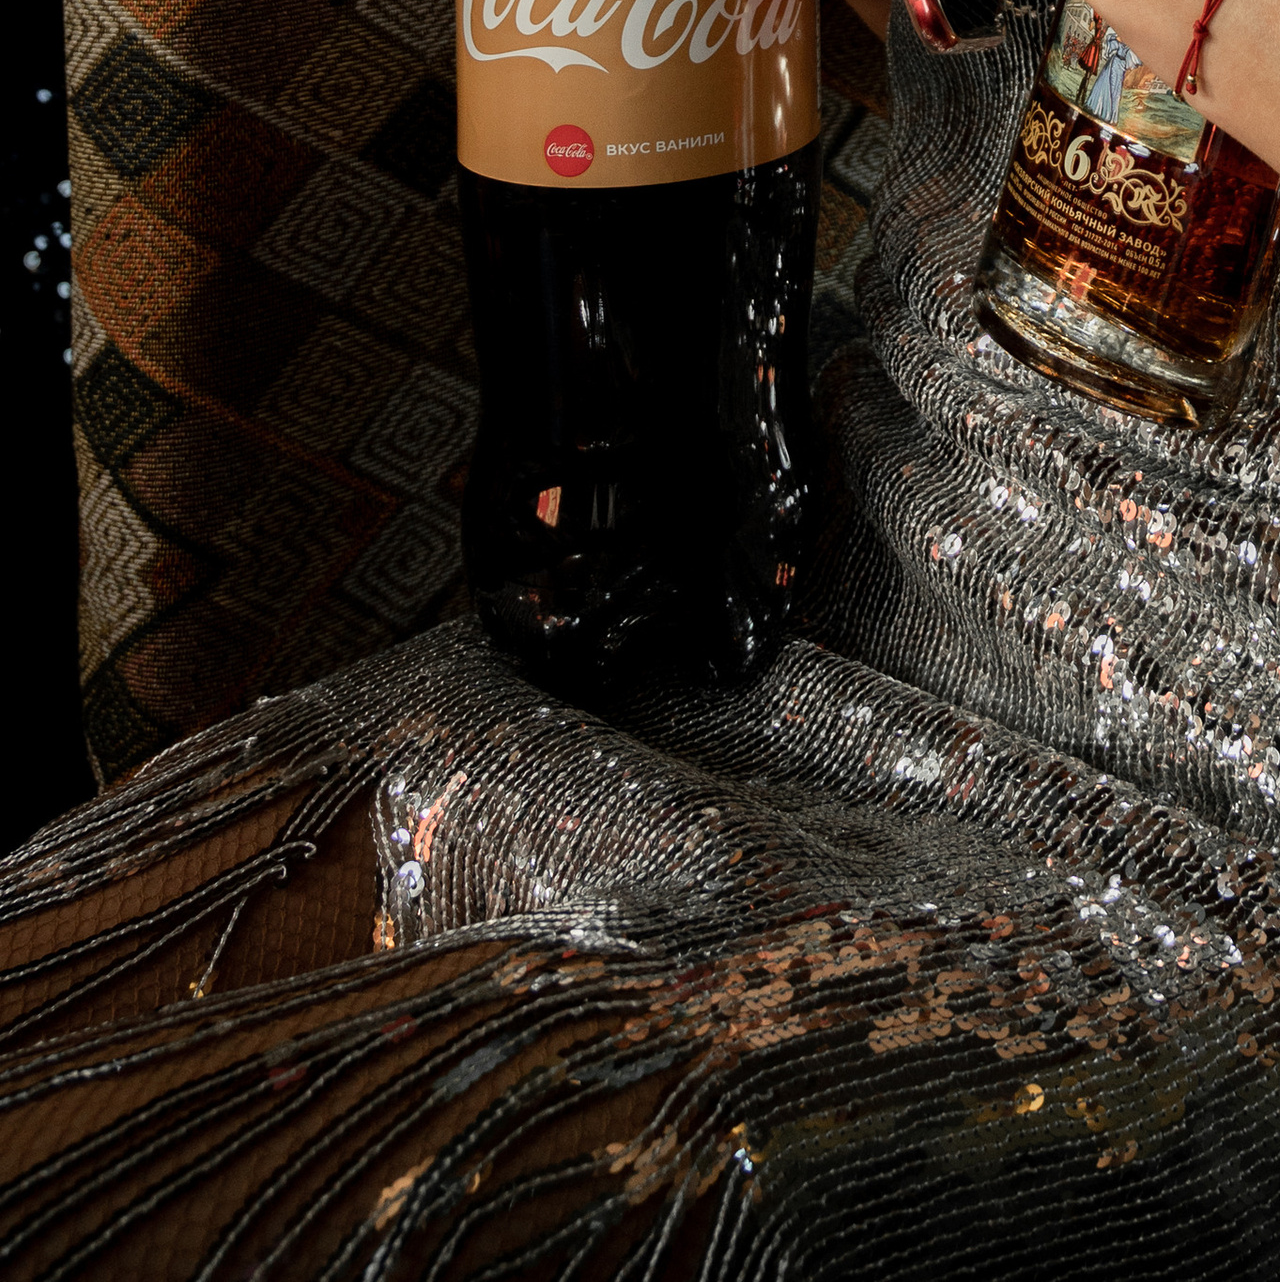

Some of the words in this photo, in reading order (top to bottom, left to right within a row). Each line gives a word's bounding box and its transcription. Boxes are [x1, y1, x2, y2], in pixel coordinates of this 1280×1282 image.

[546, 142, 588, 158] Coca-Cola
[606, 142, 651, 156] ВКУС
[655, 132, 725, 153] ВАНИЛИ
[1064, 135, 1094, 182] 6
[1073, 197, 1108, 220] ОБЩЕСТВО
[1051, 195, 1117, 238] КОНЬЯЧНЫЙ
[1118, 231, 1167, 257] ЗАВОД»
[1125, 248, 1148, 262] ОБЪЕМ
